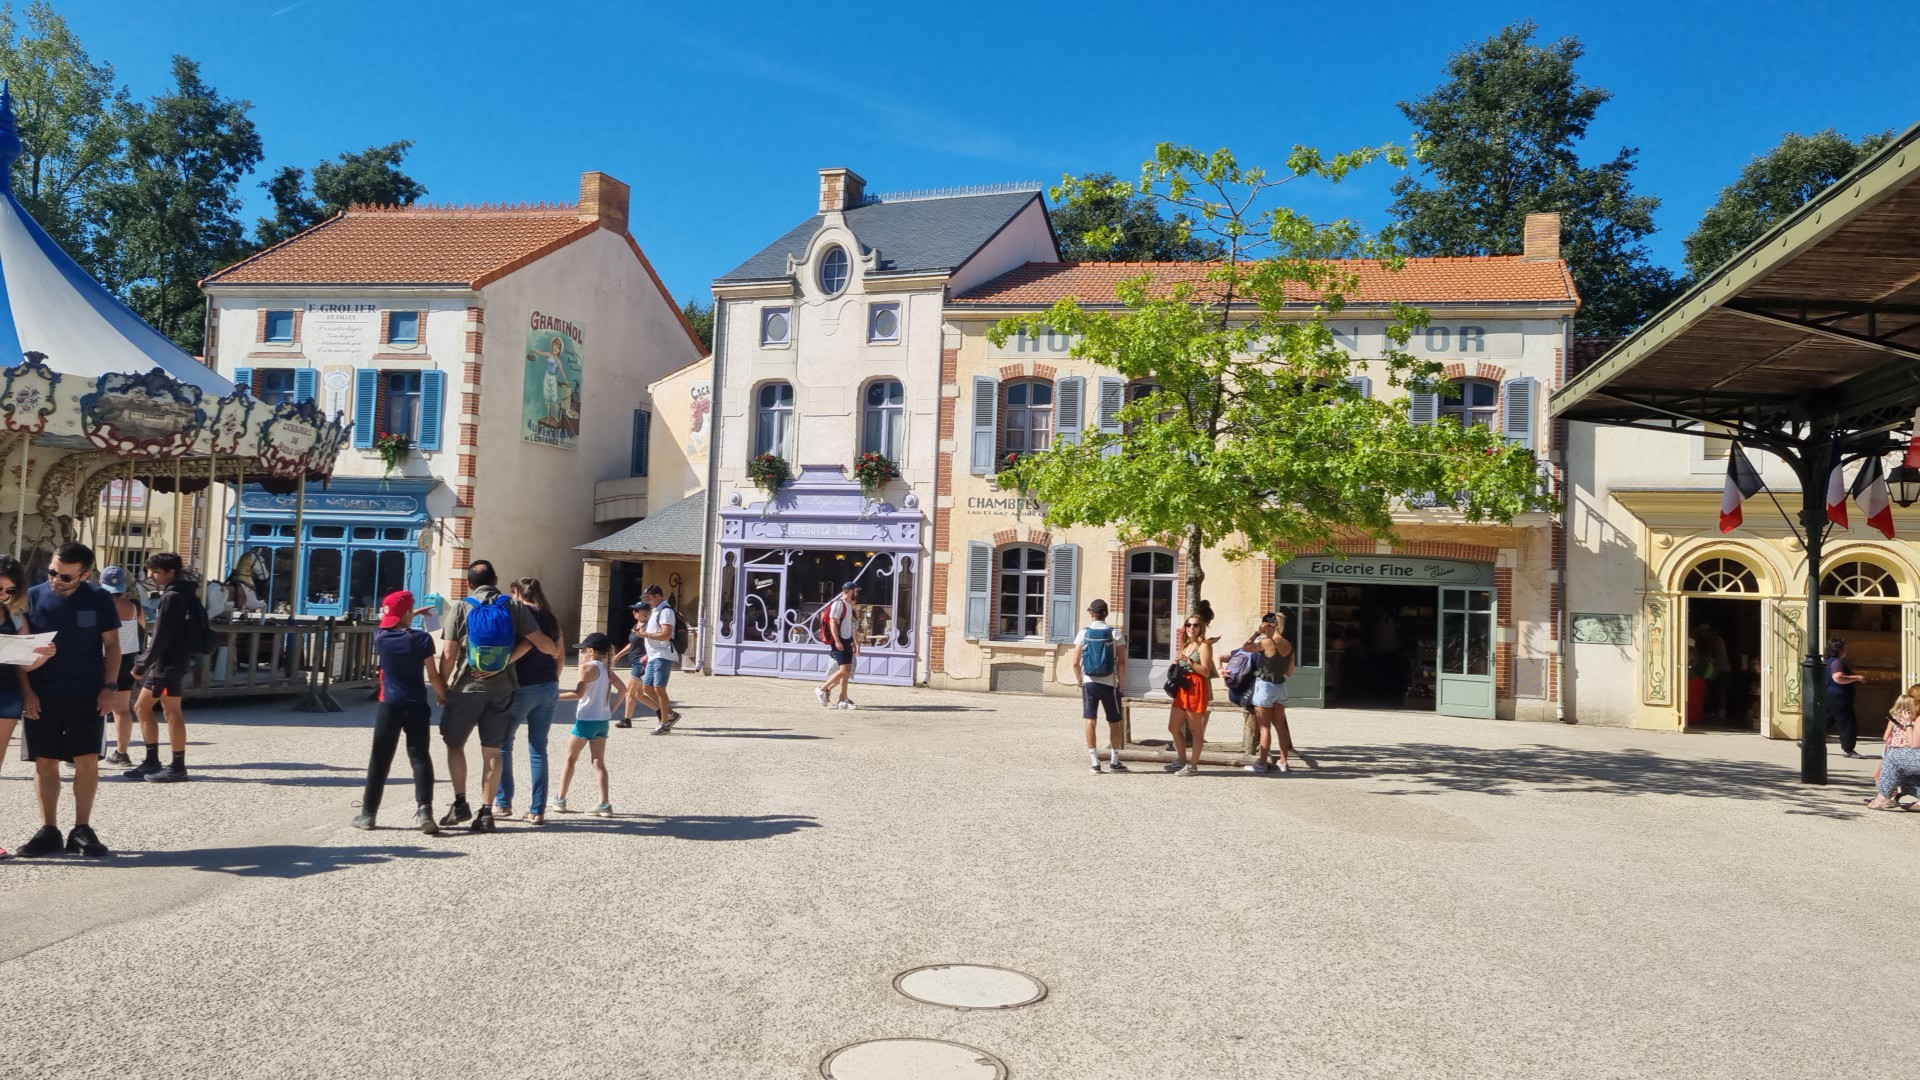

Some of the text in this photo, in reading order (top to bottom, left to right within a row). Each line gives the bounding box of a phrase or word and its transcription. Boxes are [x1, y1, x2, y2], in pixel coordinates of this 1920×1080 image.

[530, 310, 583, 345] GRAMINOL
[691, 386, 713, 400] CACA
[275, 496, 320, 507] SCIECES
[1311, 561, 1413, 576] Epicerie Fine
